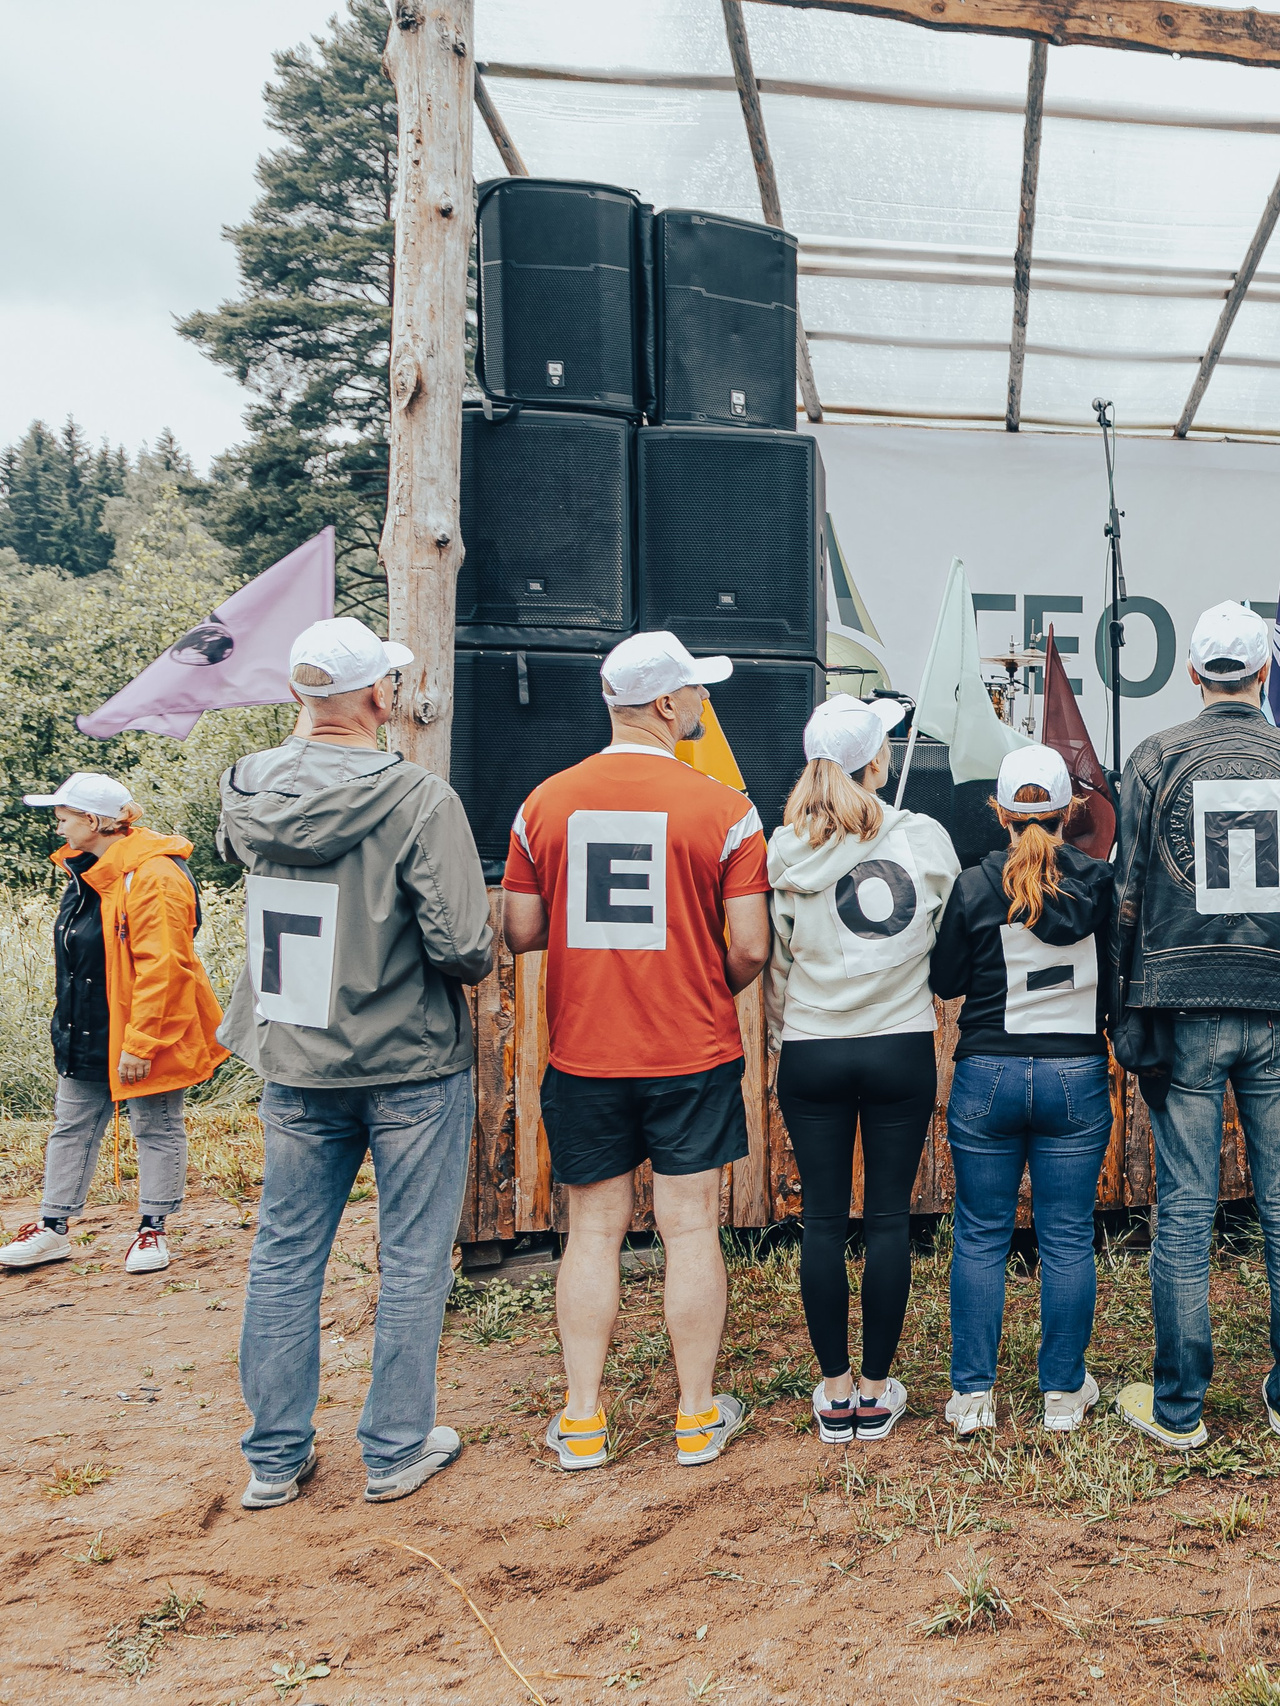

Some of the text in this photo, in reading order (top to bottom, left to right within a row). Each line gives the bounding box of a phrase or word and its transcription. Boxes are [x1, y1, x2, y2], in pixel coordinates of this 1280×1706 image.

[585, 842, 654, 924] Е
[1203, 809, 1280, 890] П
[834, 859, 918, 941] О
[261, 909, 323, 996] Г
